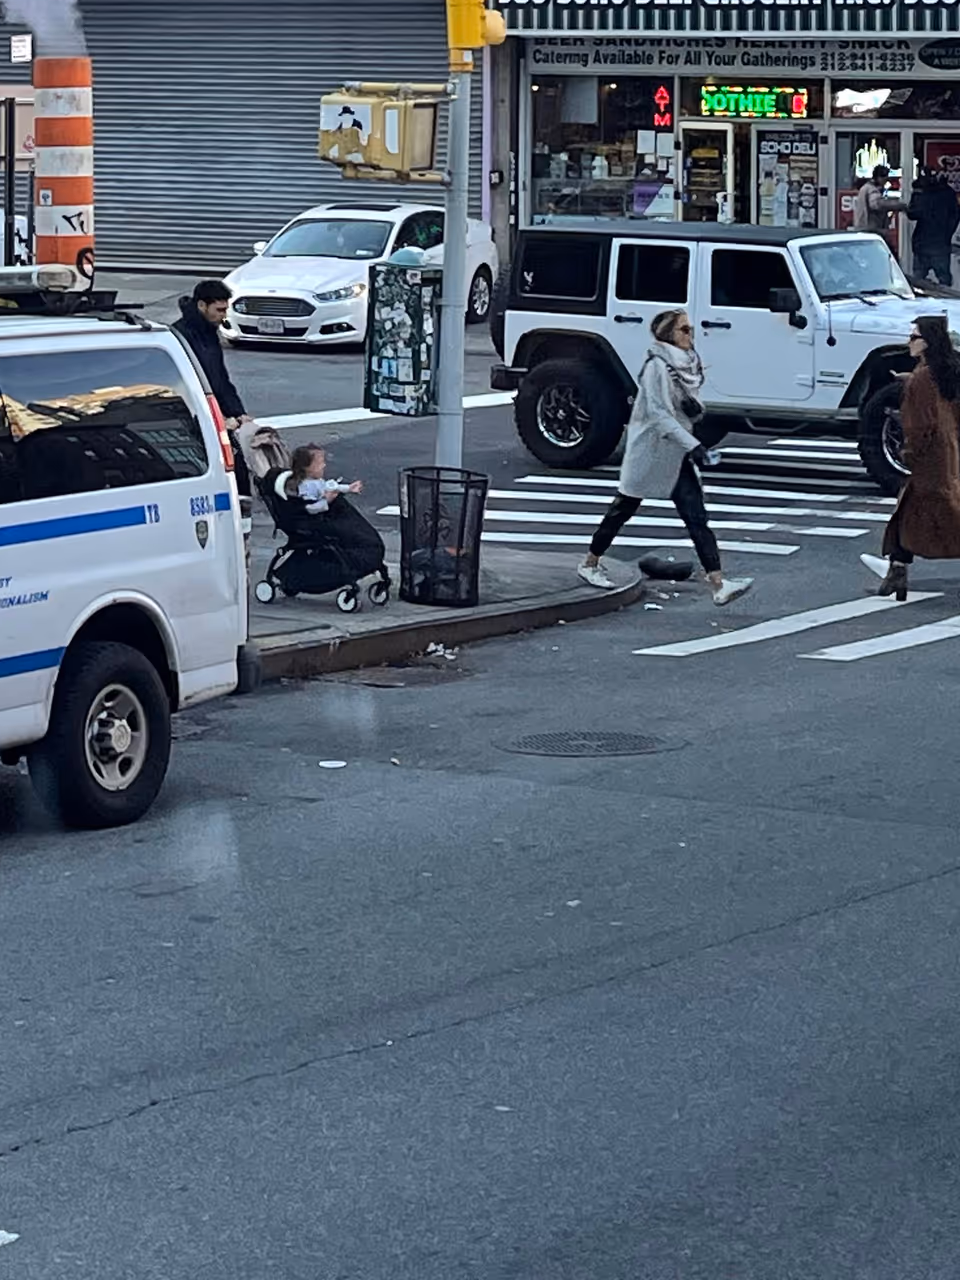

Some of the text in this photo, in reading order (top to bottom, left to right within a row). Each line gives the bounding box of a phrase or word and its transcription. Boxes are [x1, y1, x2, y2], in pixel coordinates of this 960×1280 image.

[533, 49, 589, 67] Catering
[593, 49, 654, 65] Available
[658, 50, 680, 65] For
[684, 50, 702, 66] All
[705, 50, 737, 66] Your
[740, 50, 816, 70] Gatherings
